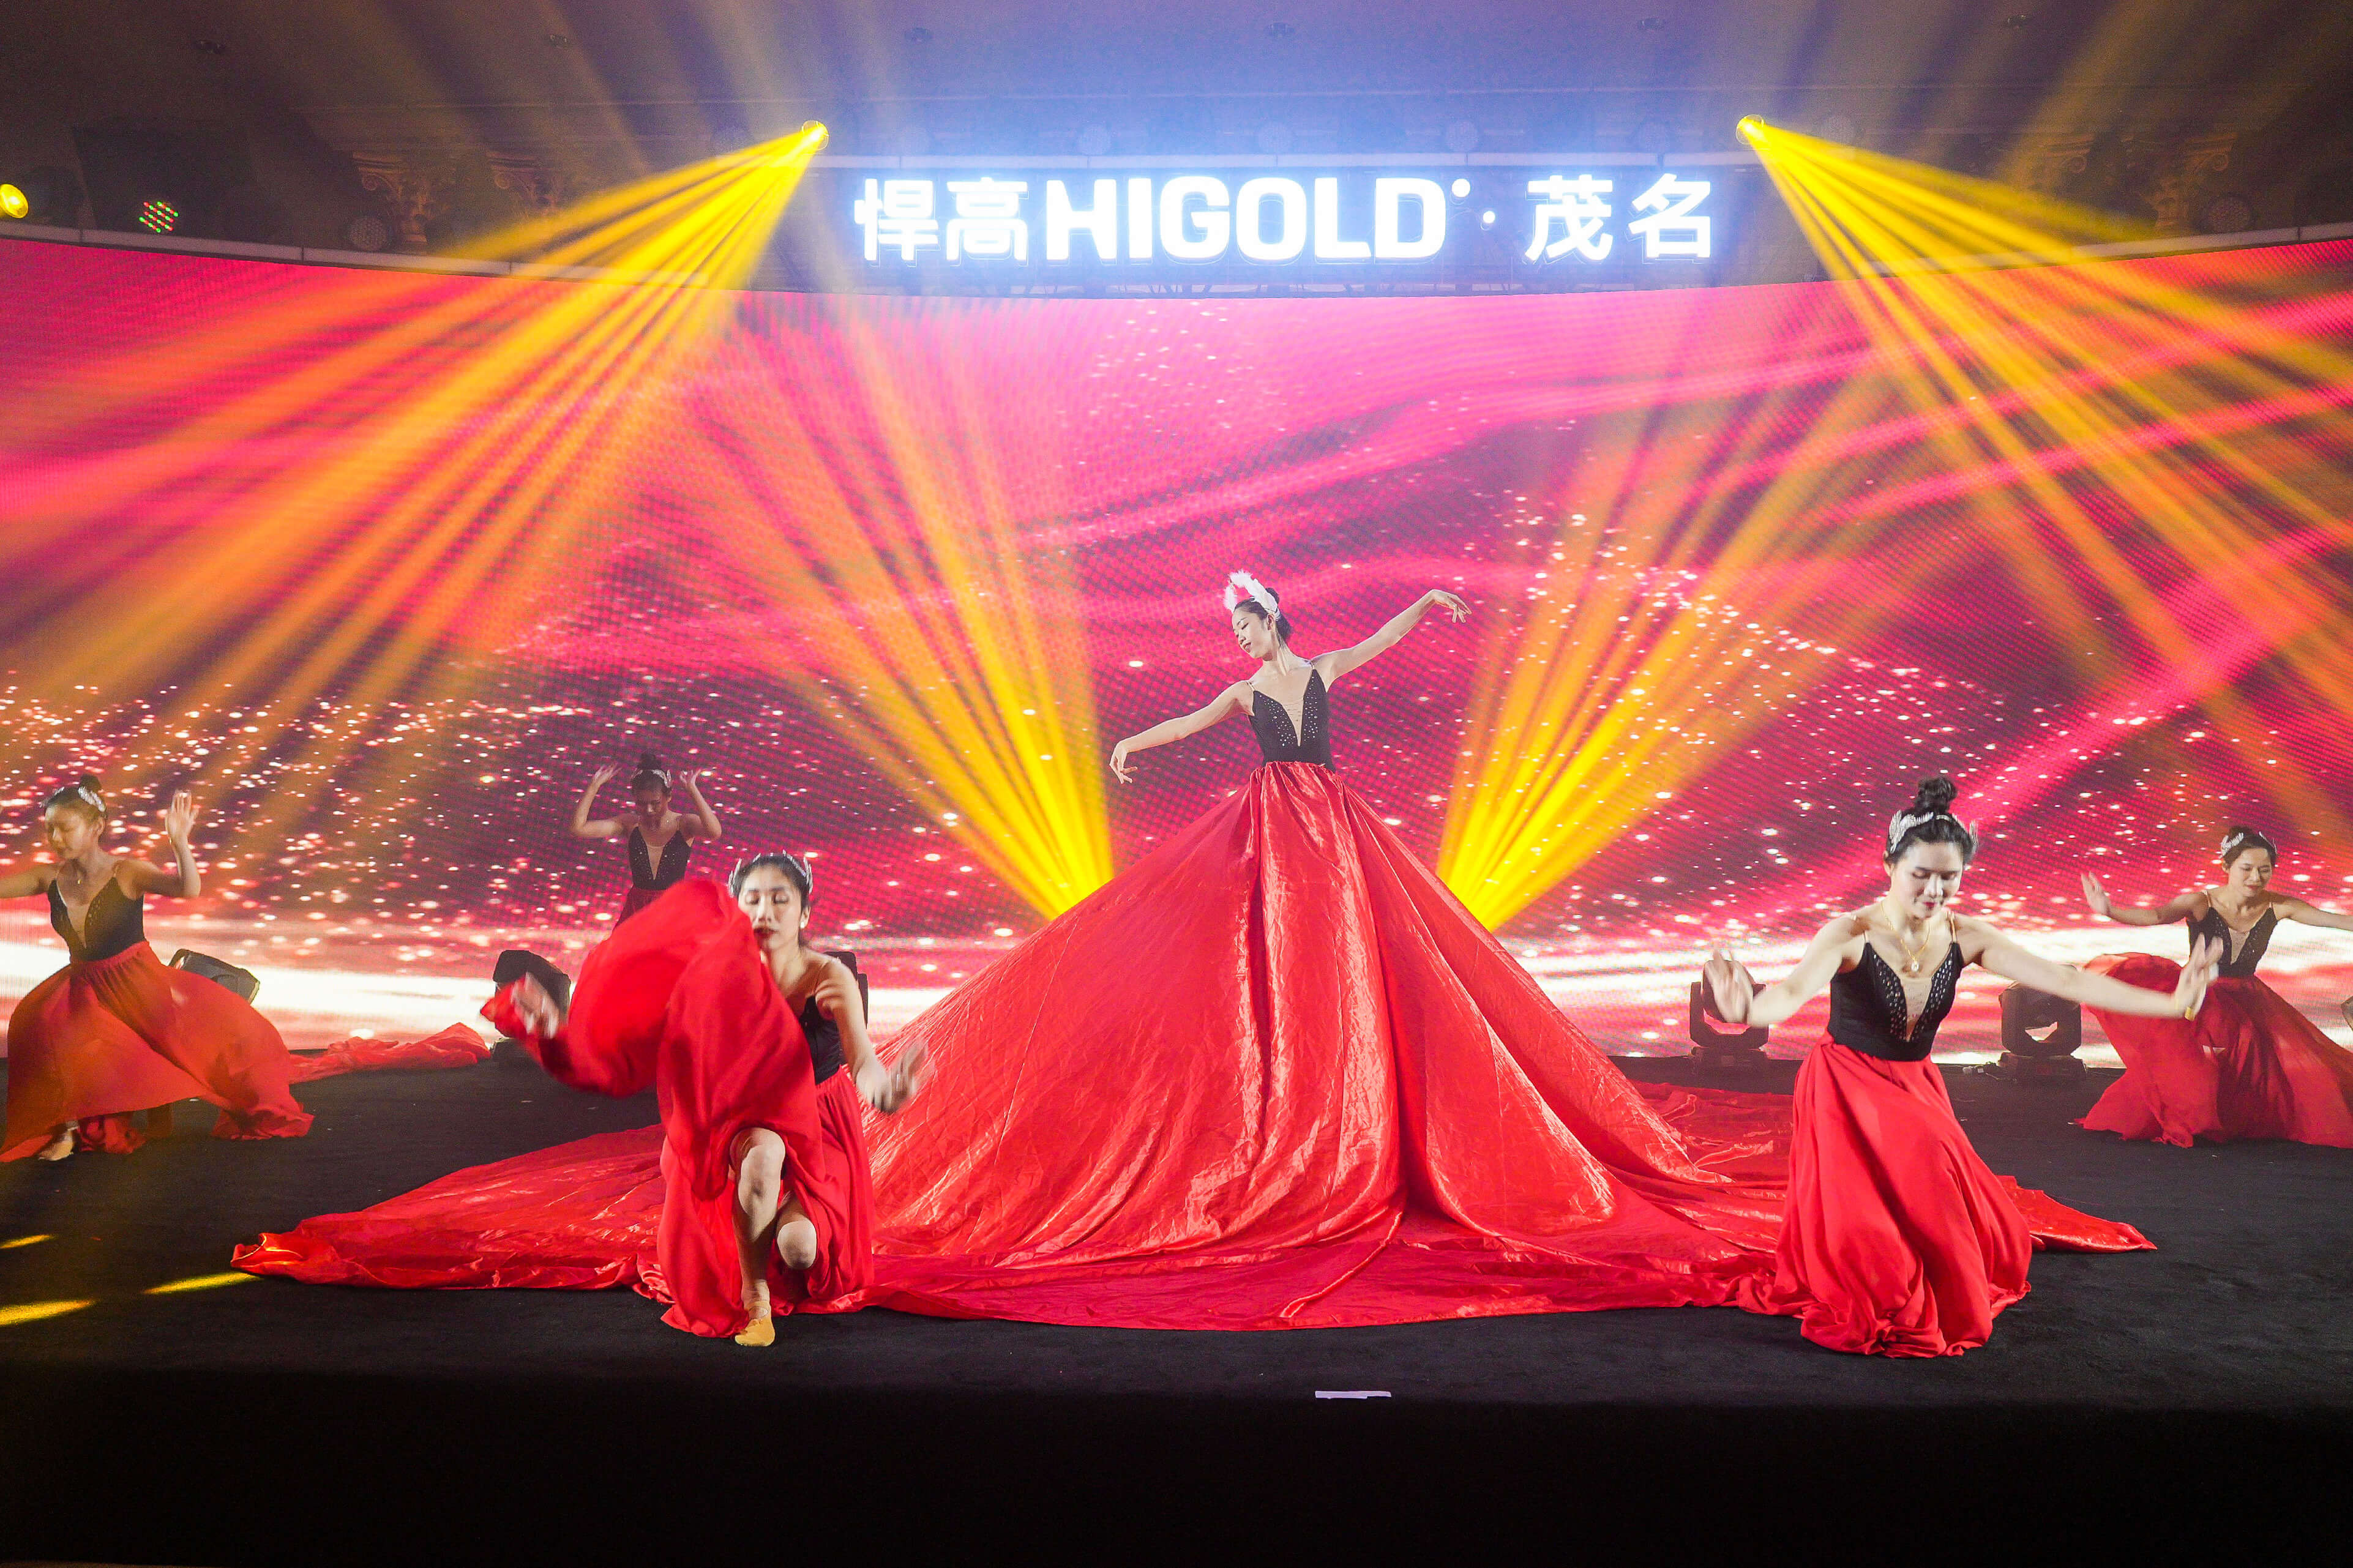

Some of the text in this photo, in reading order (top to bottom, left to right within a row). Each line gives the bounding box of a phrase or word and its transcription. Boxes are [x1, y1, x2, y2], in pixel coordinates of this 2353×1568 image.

[854, 173, 1711, 262] 悍高 HIGOLD 茂名
